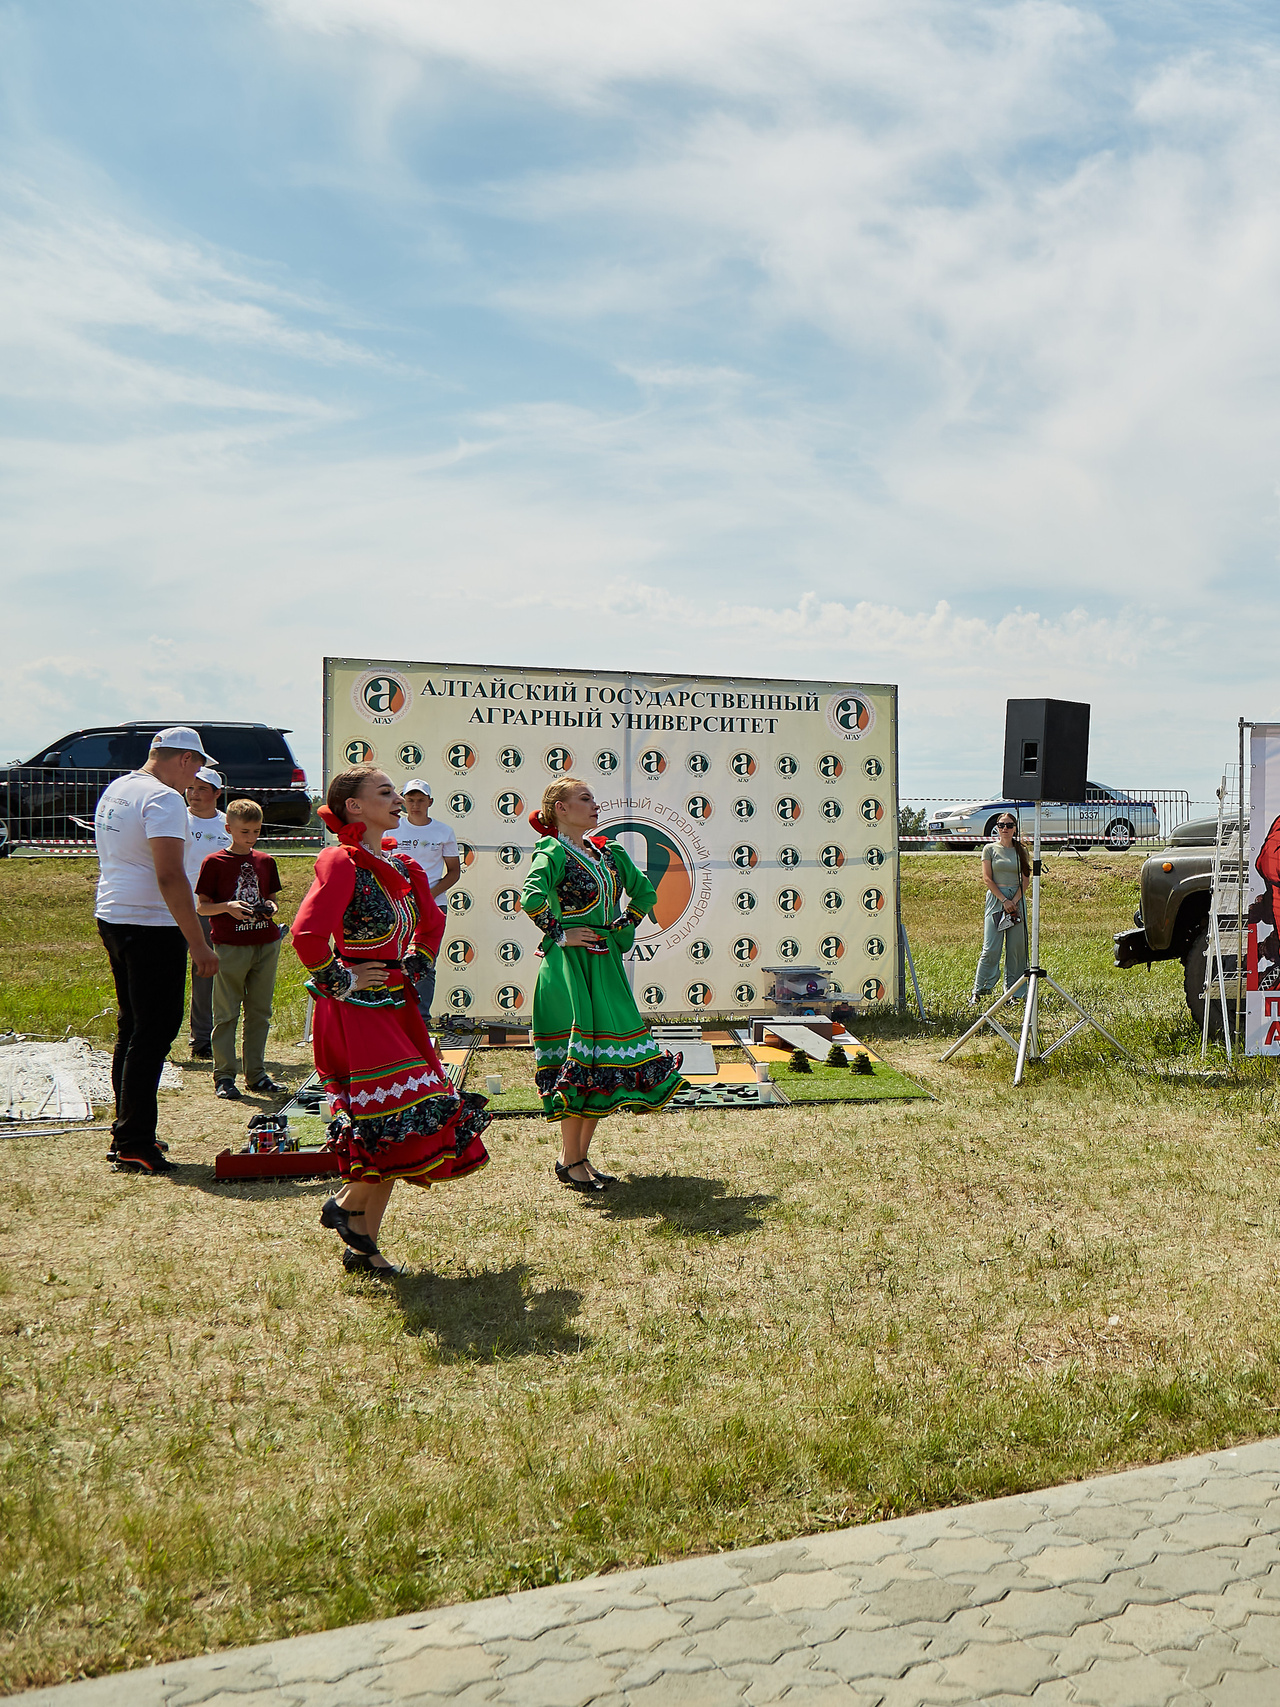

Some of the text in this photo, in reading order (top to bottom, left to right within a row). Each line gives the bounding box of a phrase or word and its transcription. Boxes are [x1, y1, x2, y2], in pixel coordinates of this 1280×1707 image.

[420, 678, 820, 713] АЛТАЙСКИЙ ГОСУДАРСТВЕННЫЙ
[468, 707, 779, 734] АГРАРНЫЙ УНИВЕРСИТЕТ
[654, 803, 711, 860] аграрный
[665, 862, 713, 950] университет
